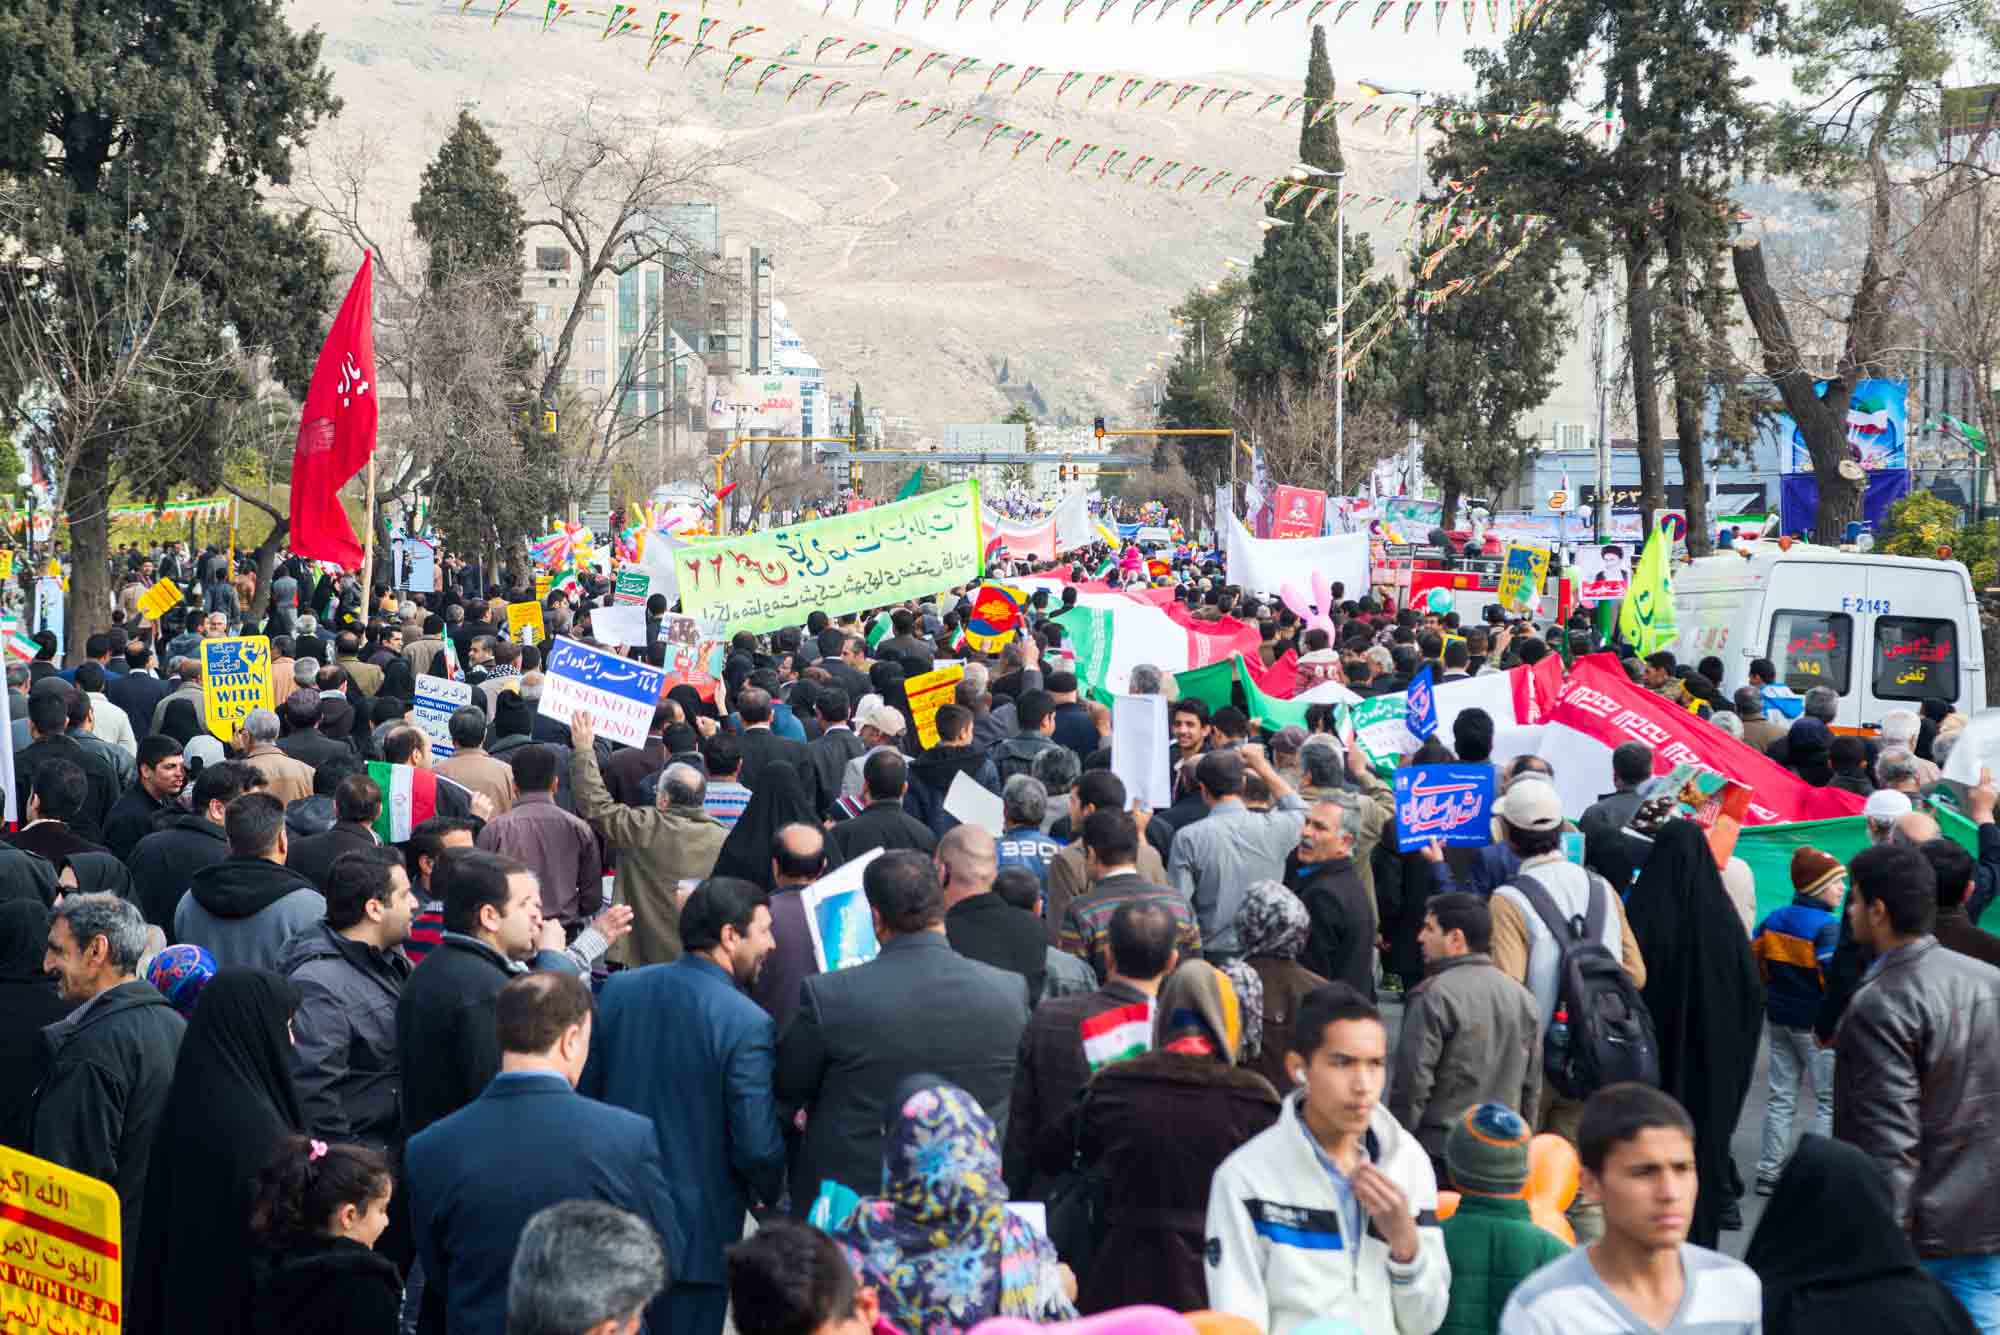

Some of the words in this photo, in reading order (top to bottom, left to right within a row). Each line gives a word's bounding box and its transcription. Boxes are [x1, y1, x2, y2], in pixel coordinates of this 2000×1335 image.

[212, 673, 263, 687] DOWN
[217, 688, 260, 702] WITH
[35, 1176, 69, 1211] الله
[42, 1247, 98, 1285] الموت
[15, 1267, 60, 1301] WITH
